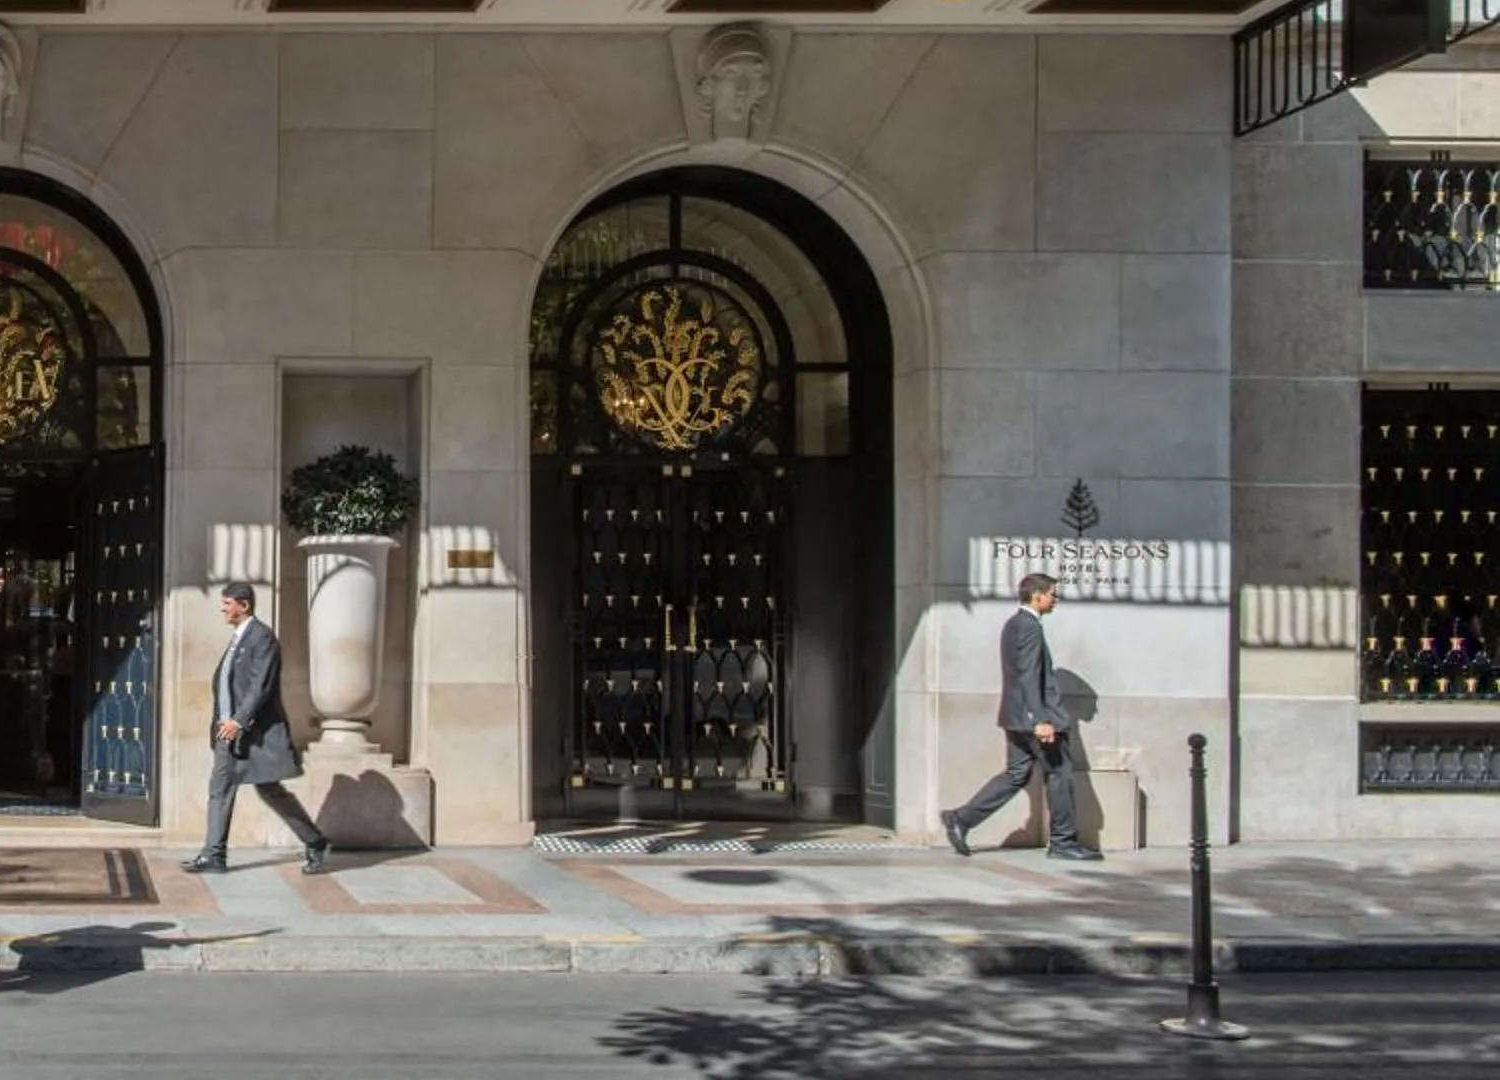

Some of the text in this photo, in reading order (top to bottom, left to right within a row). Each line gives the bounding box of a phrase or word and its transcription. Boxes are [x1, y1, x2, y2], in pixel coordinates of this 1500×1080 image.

[993, 541, 1170, 560] FOUR SEASONS
[1059, 563, 1102, 573] HOTEL
